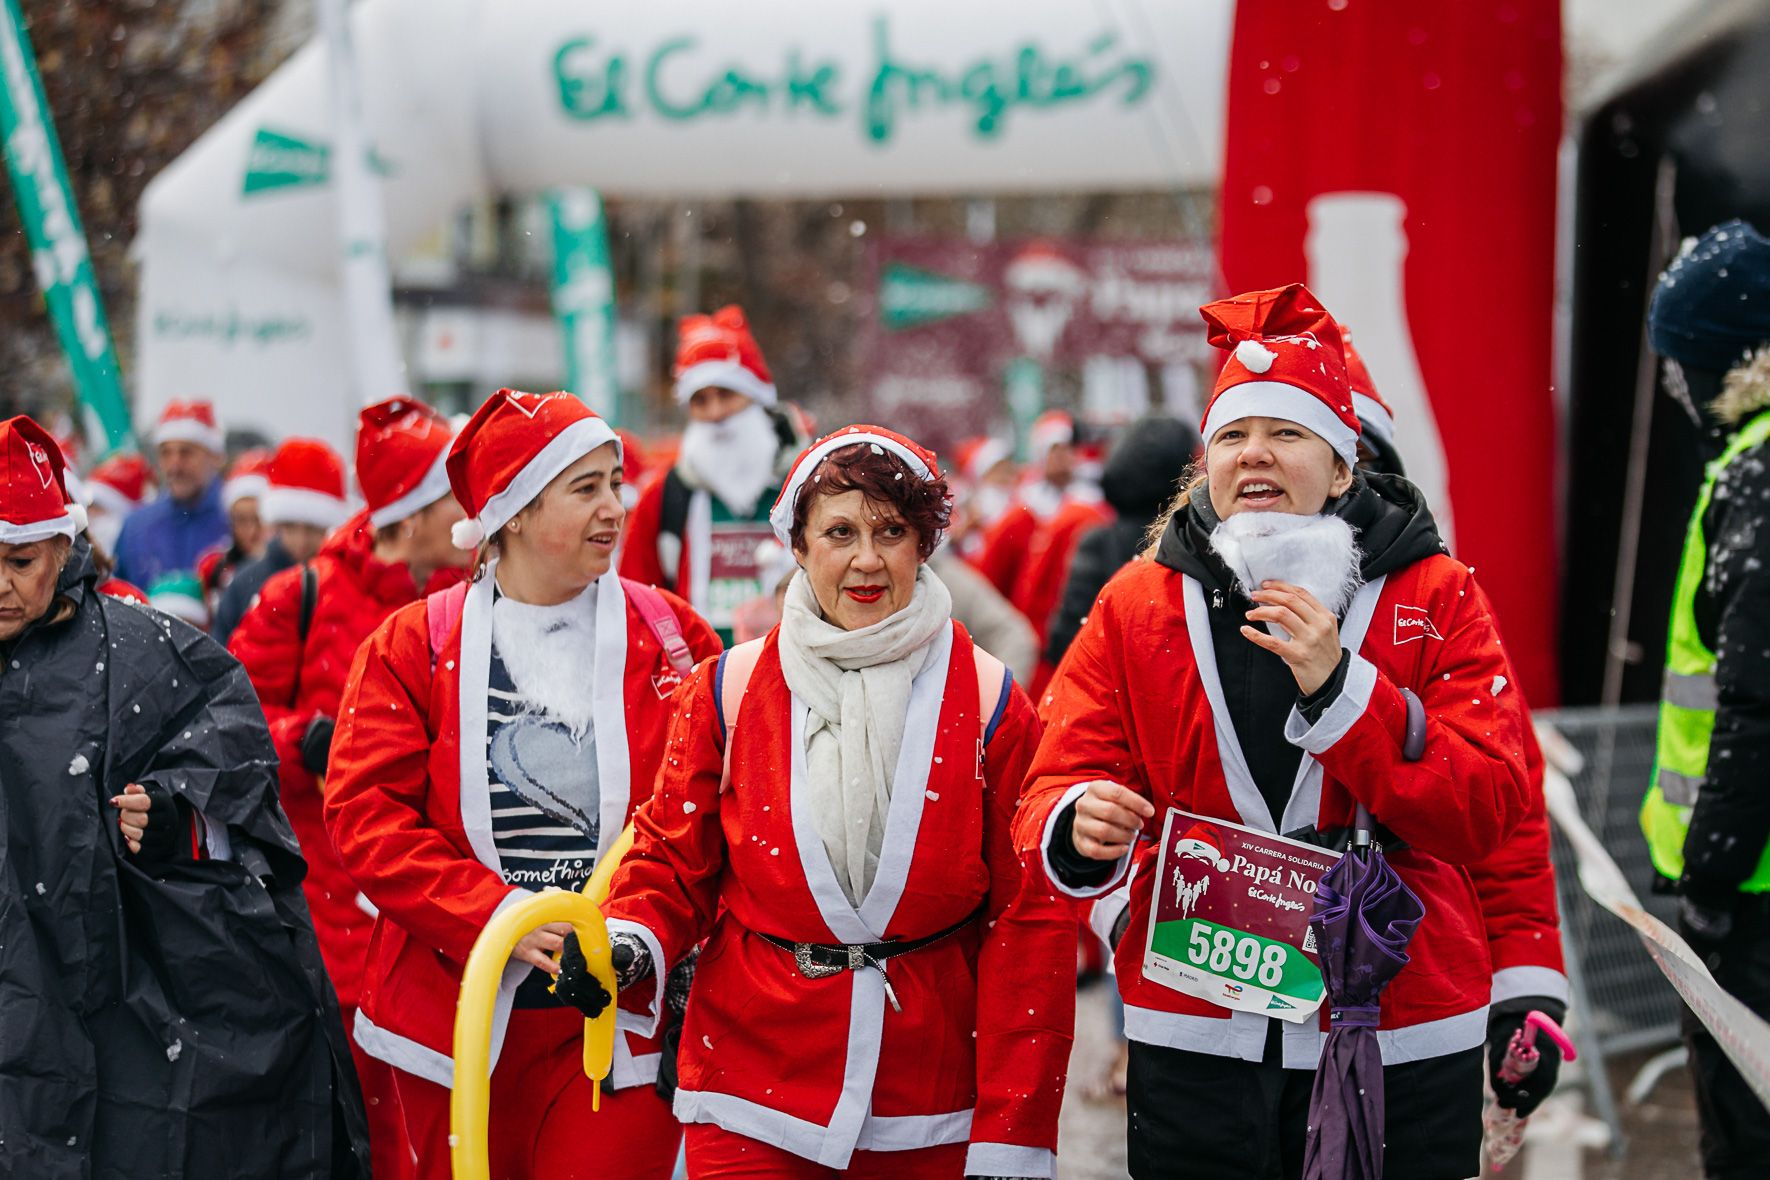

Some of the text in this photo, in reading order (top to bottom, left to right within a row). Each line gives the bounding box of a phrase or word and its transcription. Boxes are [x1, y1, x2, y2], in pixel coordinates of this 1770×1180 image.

[550, 36, 628, 122] El
[645, 38, 842, 120] Corte
[1229, 853, 1319, 894] Papá No
[1241, 842, 1254, 851] XIV
[1254, 846, 1287, 861] CARRERA
[1287, 855, 1325, 871] SOLIDARIA
[1187, 921, 1288, 988] 5898
